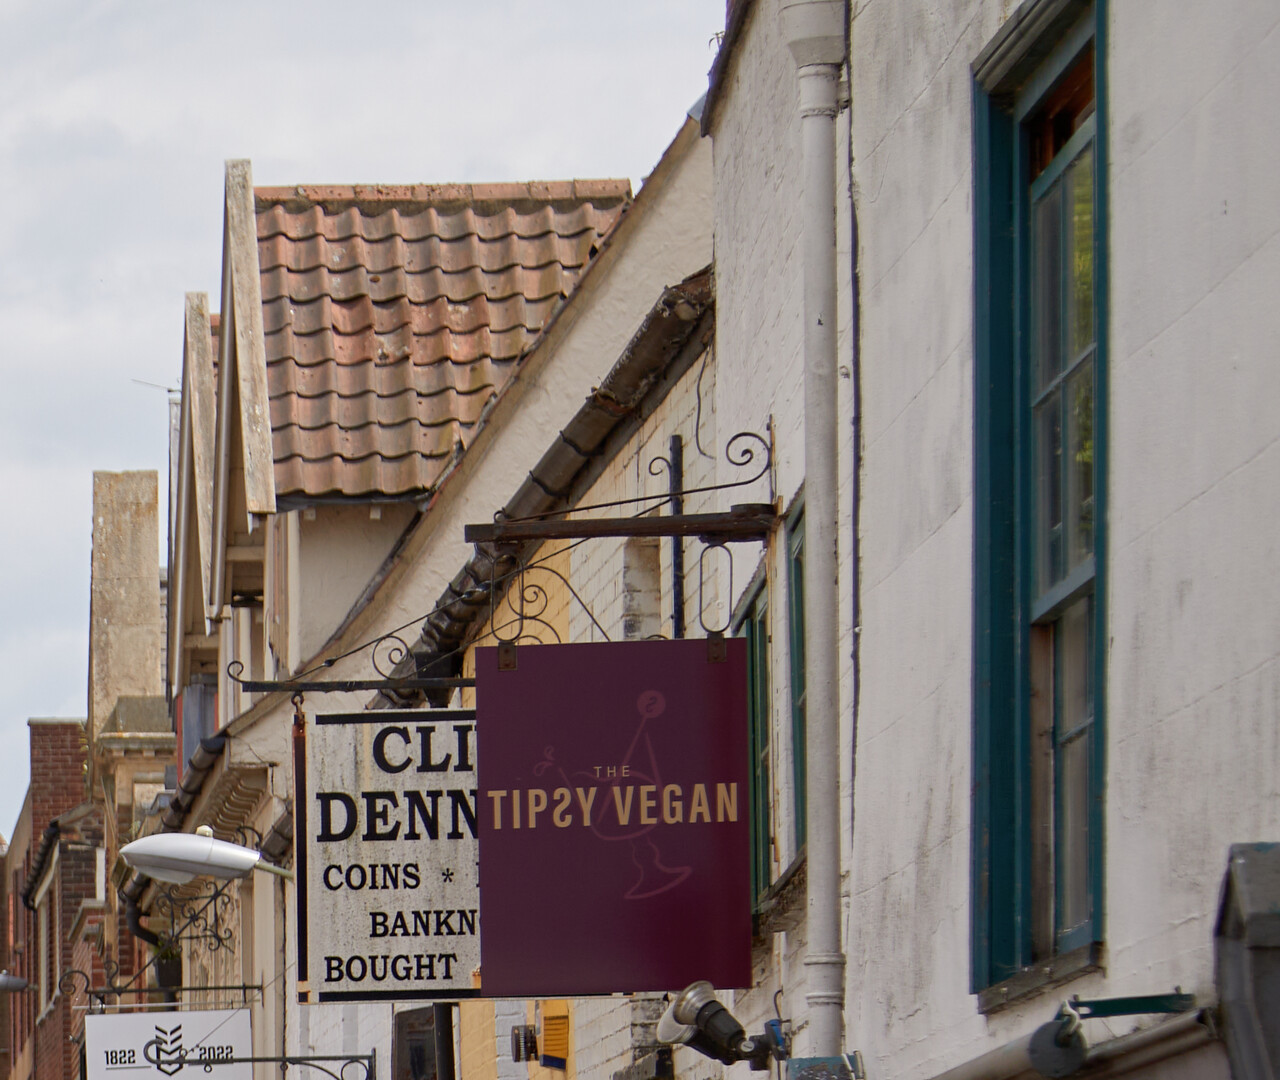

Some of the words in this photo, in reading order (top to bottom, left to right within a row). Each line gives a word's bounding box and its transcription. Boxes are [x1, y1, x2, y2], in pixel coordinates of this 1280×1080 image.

[373, 724, 477, 774] CLI
[593, 765, 631, 779] THE
[316, 788, 479, 842] DENN
[612, 782, 739, 827] VEGAN
[322, 862, 422, 891] COINS
[369, 909, 478, 938] BANKN
[324, 952, 458, 983] BOUGHT
[104, 1049, 136, 1065] 1822
[199, 1045, 235, 1062] 2022
